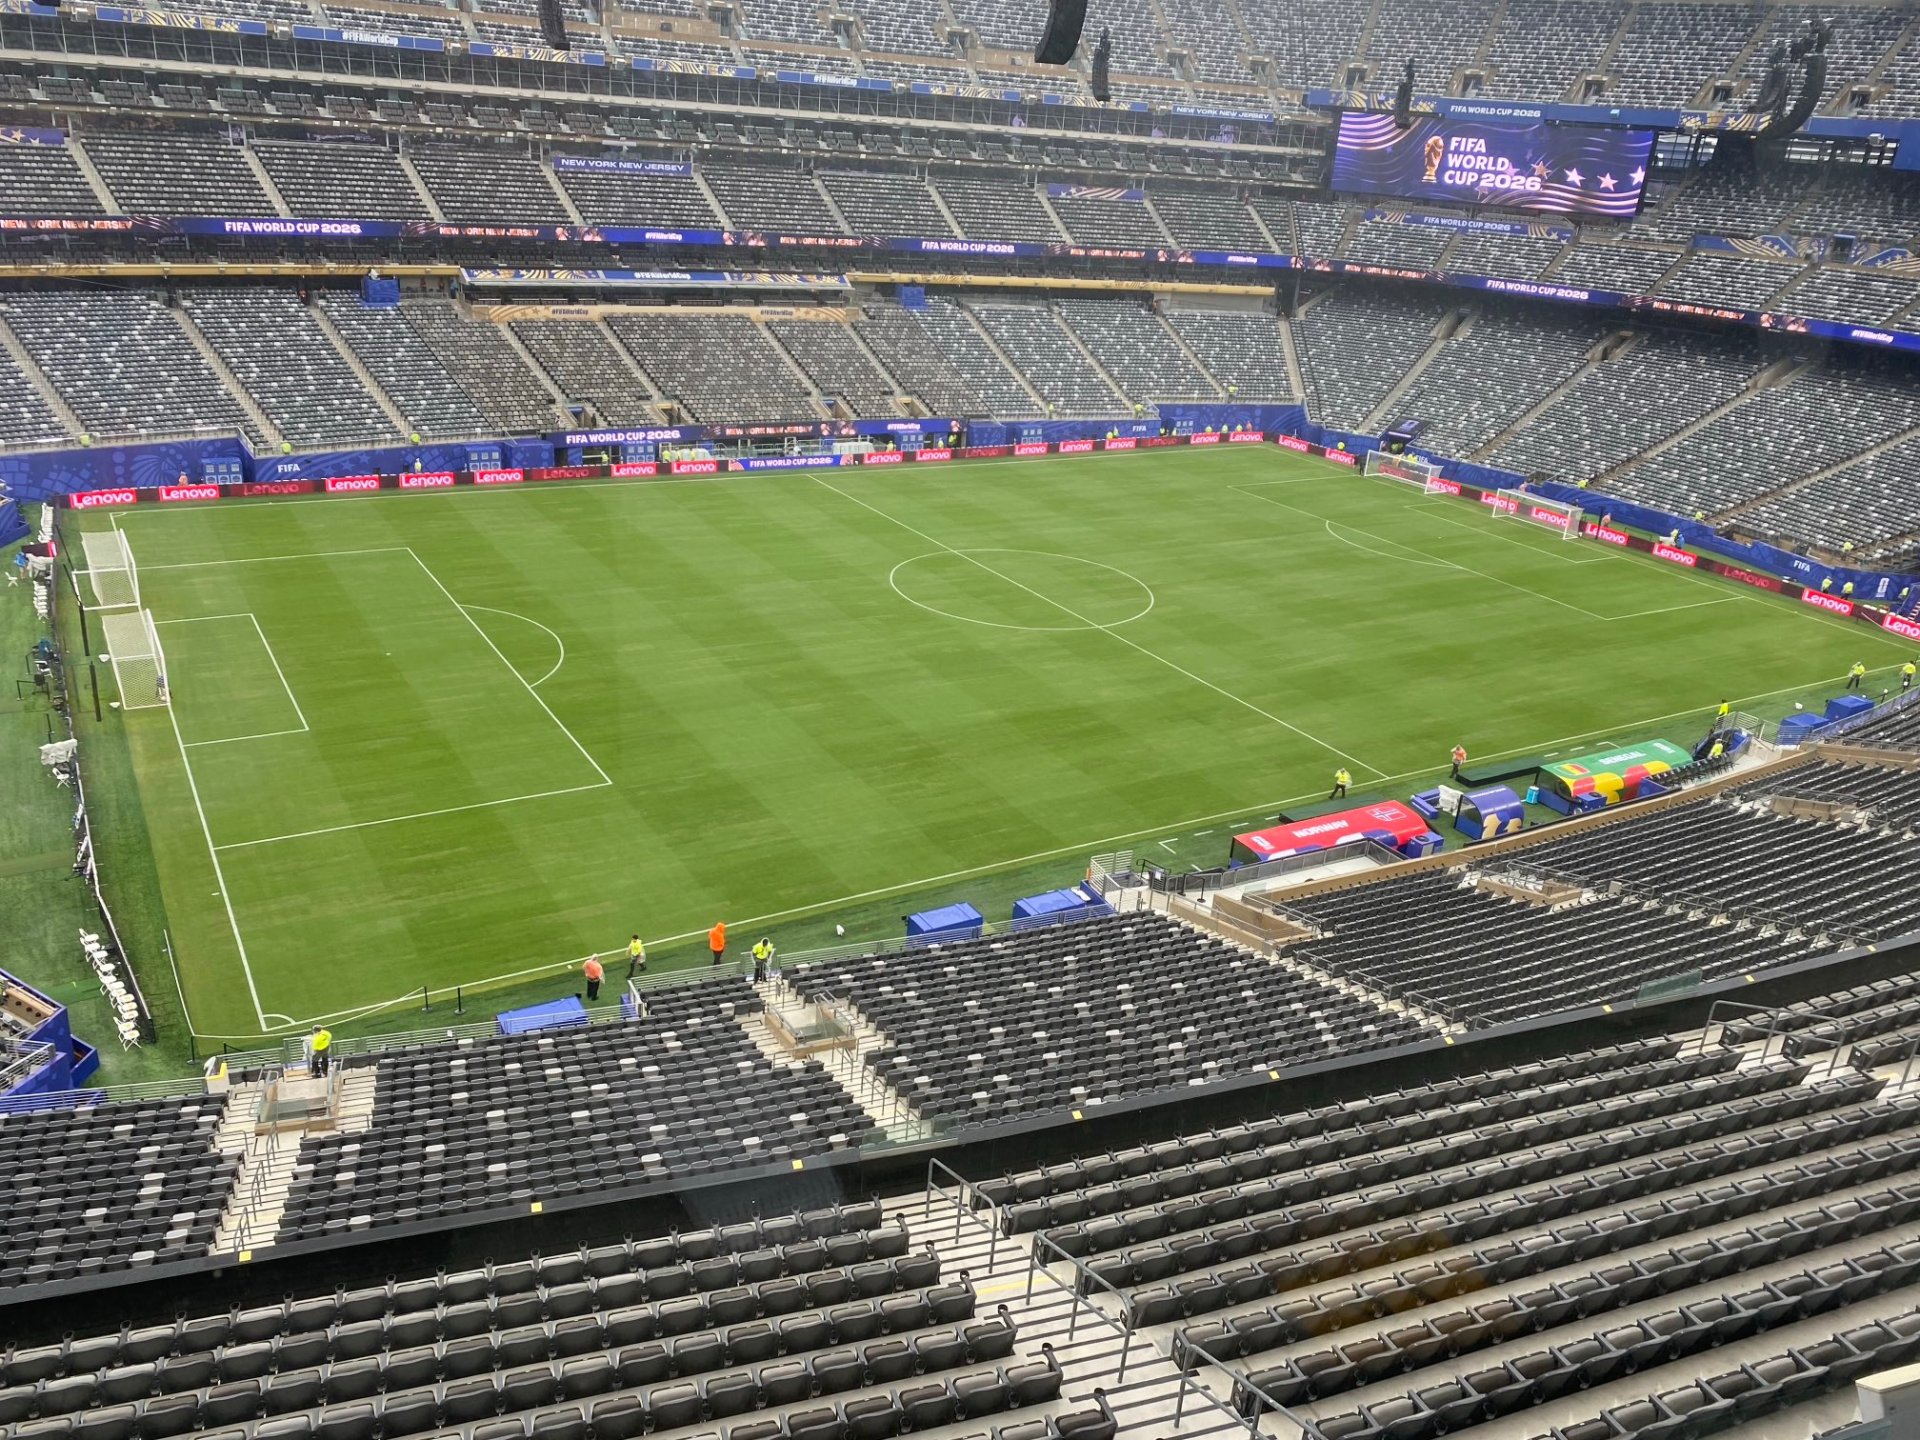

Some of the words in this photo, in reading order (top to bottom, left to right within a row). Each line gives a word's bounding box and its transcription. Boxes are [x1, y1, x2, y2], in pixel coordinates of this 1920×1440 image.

[342, 29, 398, 47] #FIFAWorldCup
[1176, 106, 1195, 114] NEW
[1219, 110, 1237, 118] NEW
[1450, 105, 1467, 113] FIFA
[1468, 106, 1495, 115] WORLD
[1496, 108, 1512, 116] CUP
[1512, 109, 1541, 118] 2026
[1449, 136, 1487, 153] FIFA
[561, 159, 586, 167] NEW
[588, 160, 616, 168] YORK
[644, 163, 684, 171] JERSEY
[1447, 153, 1509, 171] WORLD
[1444, 170, 1478, 186] CUP
[1479, 173, 1542, 191] 2026
[0, 219, 27, 229] NEW
[63, 220, 88, 229] NEW
[90, 220, 133, 230] JERSEY
[225, 222, 252, 232] FIFA
[252, 222, 296, 232] WORLD
[296, 223, 320, 233] CUP
[320, 223, 362, 234] 2026
[1423, 216, 1440, 225] FIFA
[1440, 217, 1468, 227] WORLD
[1468, 220, 1484, 229] CUP
[1483, 222, 1511, 231] 2026
[440, 226, 459, 235] NEW
[486, 227, 505, 236] NEW
[506, 228, 539, 237] JERSEY
[780, 236, 799, 245] NEW
[818, 237, 835, 246] NEW
[835, 238, 862, 246] JERSEY
[922, 241, 939, 250] FIFA
[940, 242, 969, 251] WORLD
[969, 243, 986, 252] CUP
[986, 244, 1015, 253] 2026
[634, 271, 692, 281] #FIFAWorldCup
[1487, 279, 1506, 289] FIFA
[1506, 281, 1538, 293] WORLD
[1538, 285, 1557, 296] CUP
[1557, 288, 1589, 300] 2026
[1653, 301, 1671, 311] NEW
[1713, 309, 1745, 320] JERSEY
[566, 434, 589, 445] FIFA
[589, 432, 625, 443] WORLD
[626, 431, 646, 442] CUP
[646, 429, 681, 440] 2026
[726, 427, 743, 436] NEW
[1230, 432, 1261, 442] Lenovo
[1106, 438, 1135, 450] Lenovo
[1191, 433, 1219, 444] Lenovo
[1280, 435, 1307, 451] Lenovo
[1015, 444, 1046, 455] Lenovo
[1060, 441, 1092, 453] Lenovo
[865, 453, 902, 465] Lenovo
[917, 449, 950, 461] Lenovo
[1416, 454, 1428, 464] IFA
[278, 463, 301, 473] FIFA
[674, 461, 715, 474] Lenovo
[750, 460, 765, 468] FIFA
[766, 459, 793, 468] WORLD
[793, 458, 807, 466] CUP
[807, 457, 832, 465] 2026
[476, 470, 521, 483] Lenovo
[543, 468, 589, 480] Lenovo
[613, 464, 654, 476] Lenovo
[328, 478, 377, 491] Lenovo
[402, 473, 452, 487] Lenovo
[161, 486, 217, 500] Lenovo
[244, 483, 299, 496] Lenovo
[72, 491, 133, 508] Lenovo
[1532, 507, 1569, 527] Lenovo
[1586, 523, 1626, 544] Lenovo
[1653, 544, 1694, 566] Lenovo
[1793, 559, 1811, 572] FIFA
[1724, 566, 1769, 588] Lenovo
[1803, 590, 1850, 613] Lenovo
[1291, 819, 1349, 838] NORWAY
